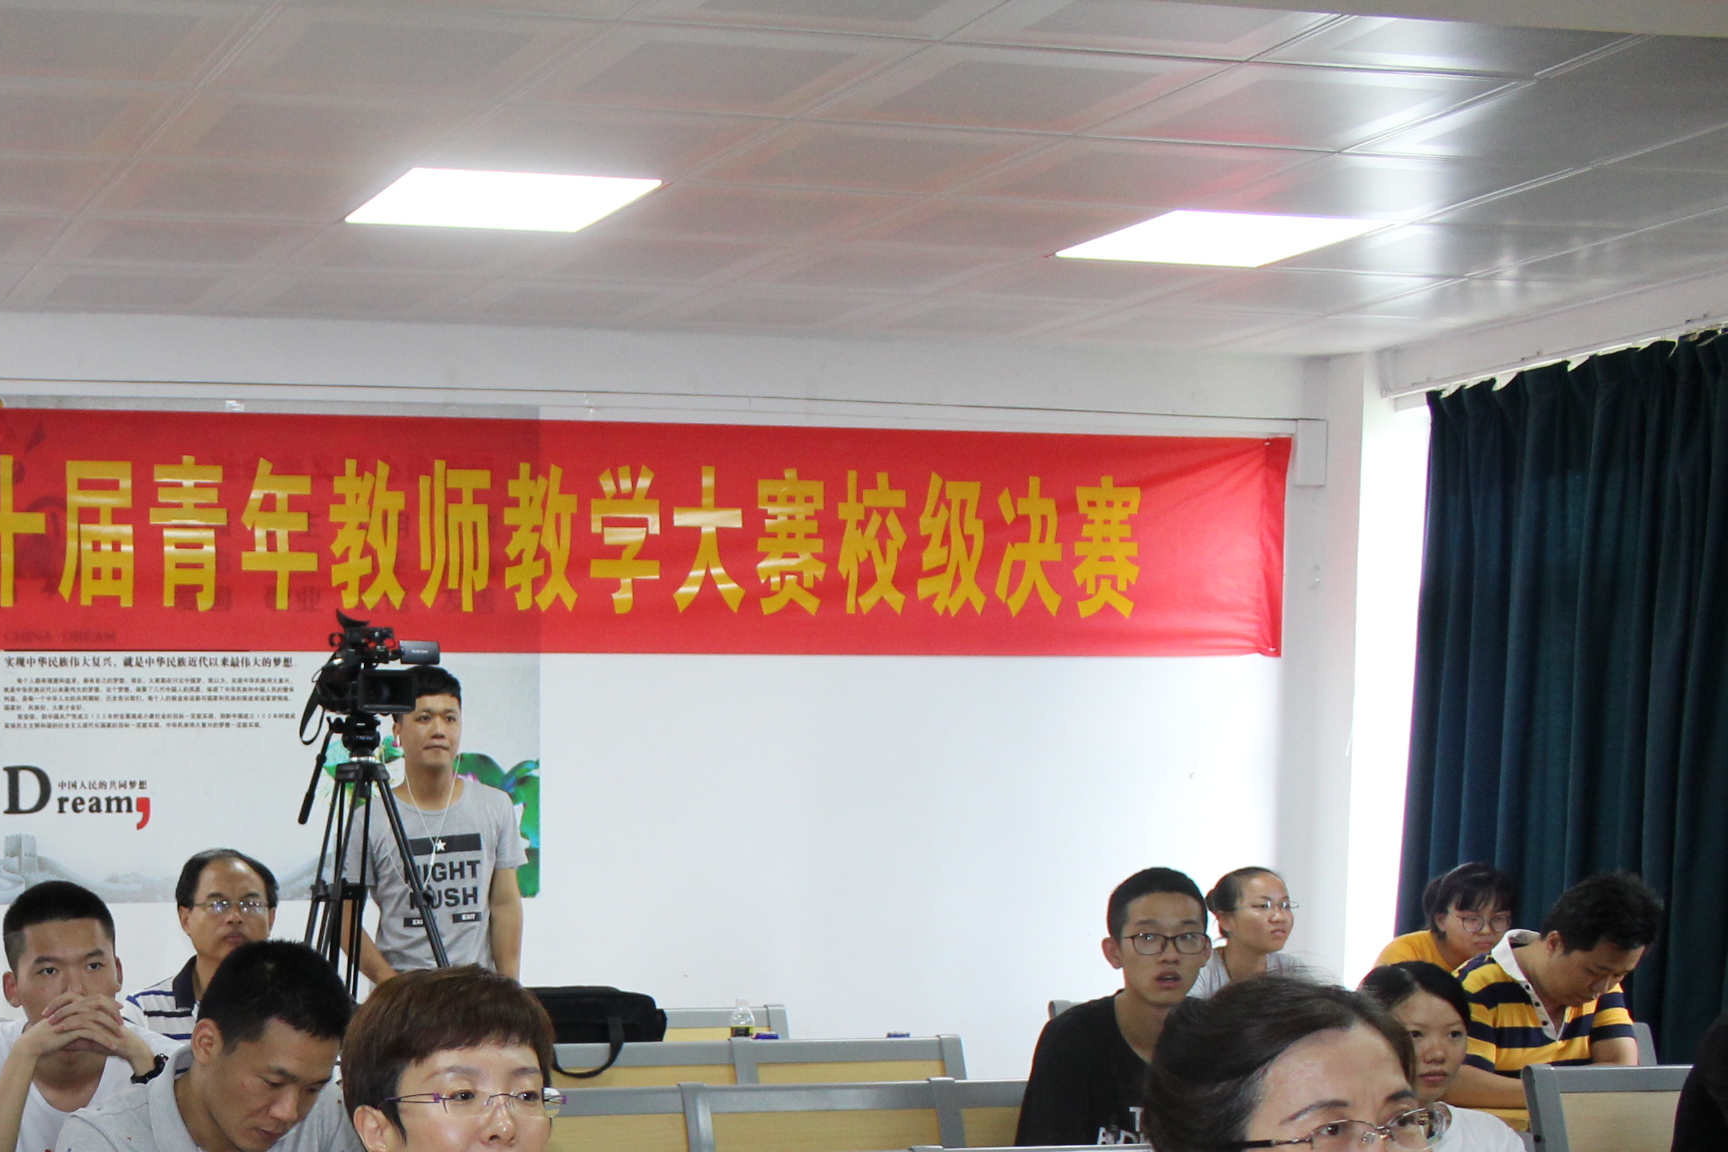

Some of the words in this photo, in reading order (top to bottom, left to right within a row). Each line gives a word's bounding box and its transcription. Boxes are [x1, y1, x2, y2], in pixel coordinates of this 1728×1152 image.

[57, 780, 148, 790] 中国人民的共同梦想
